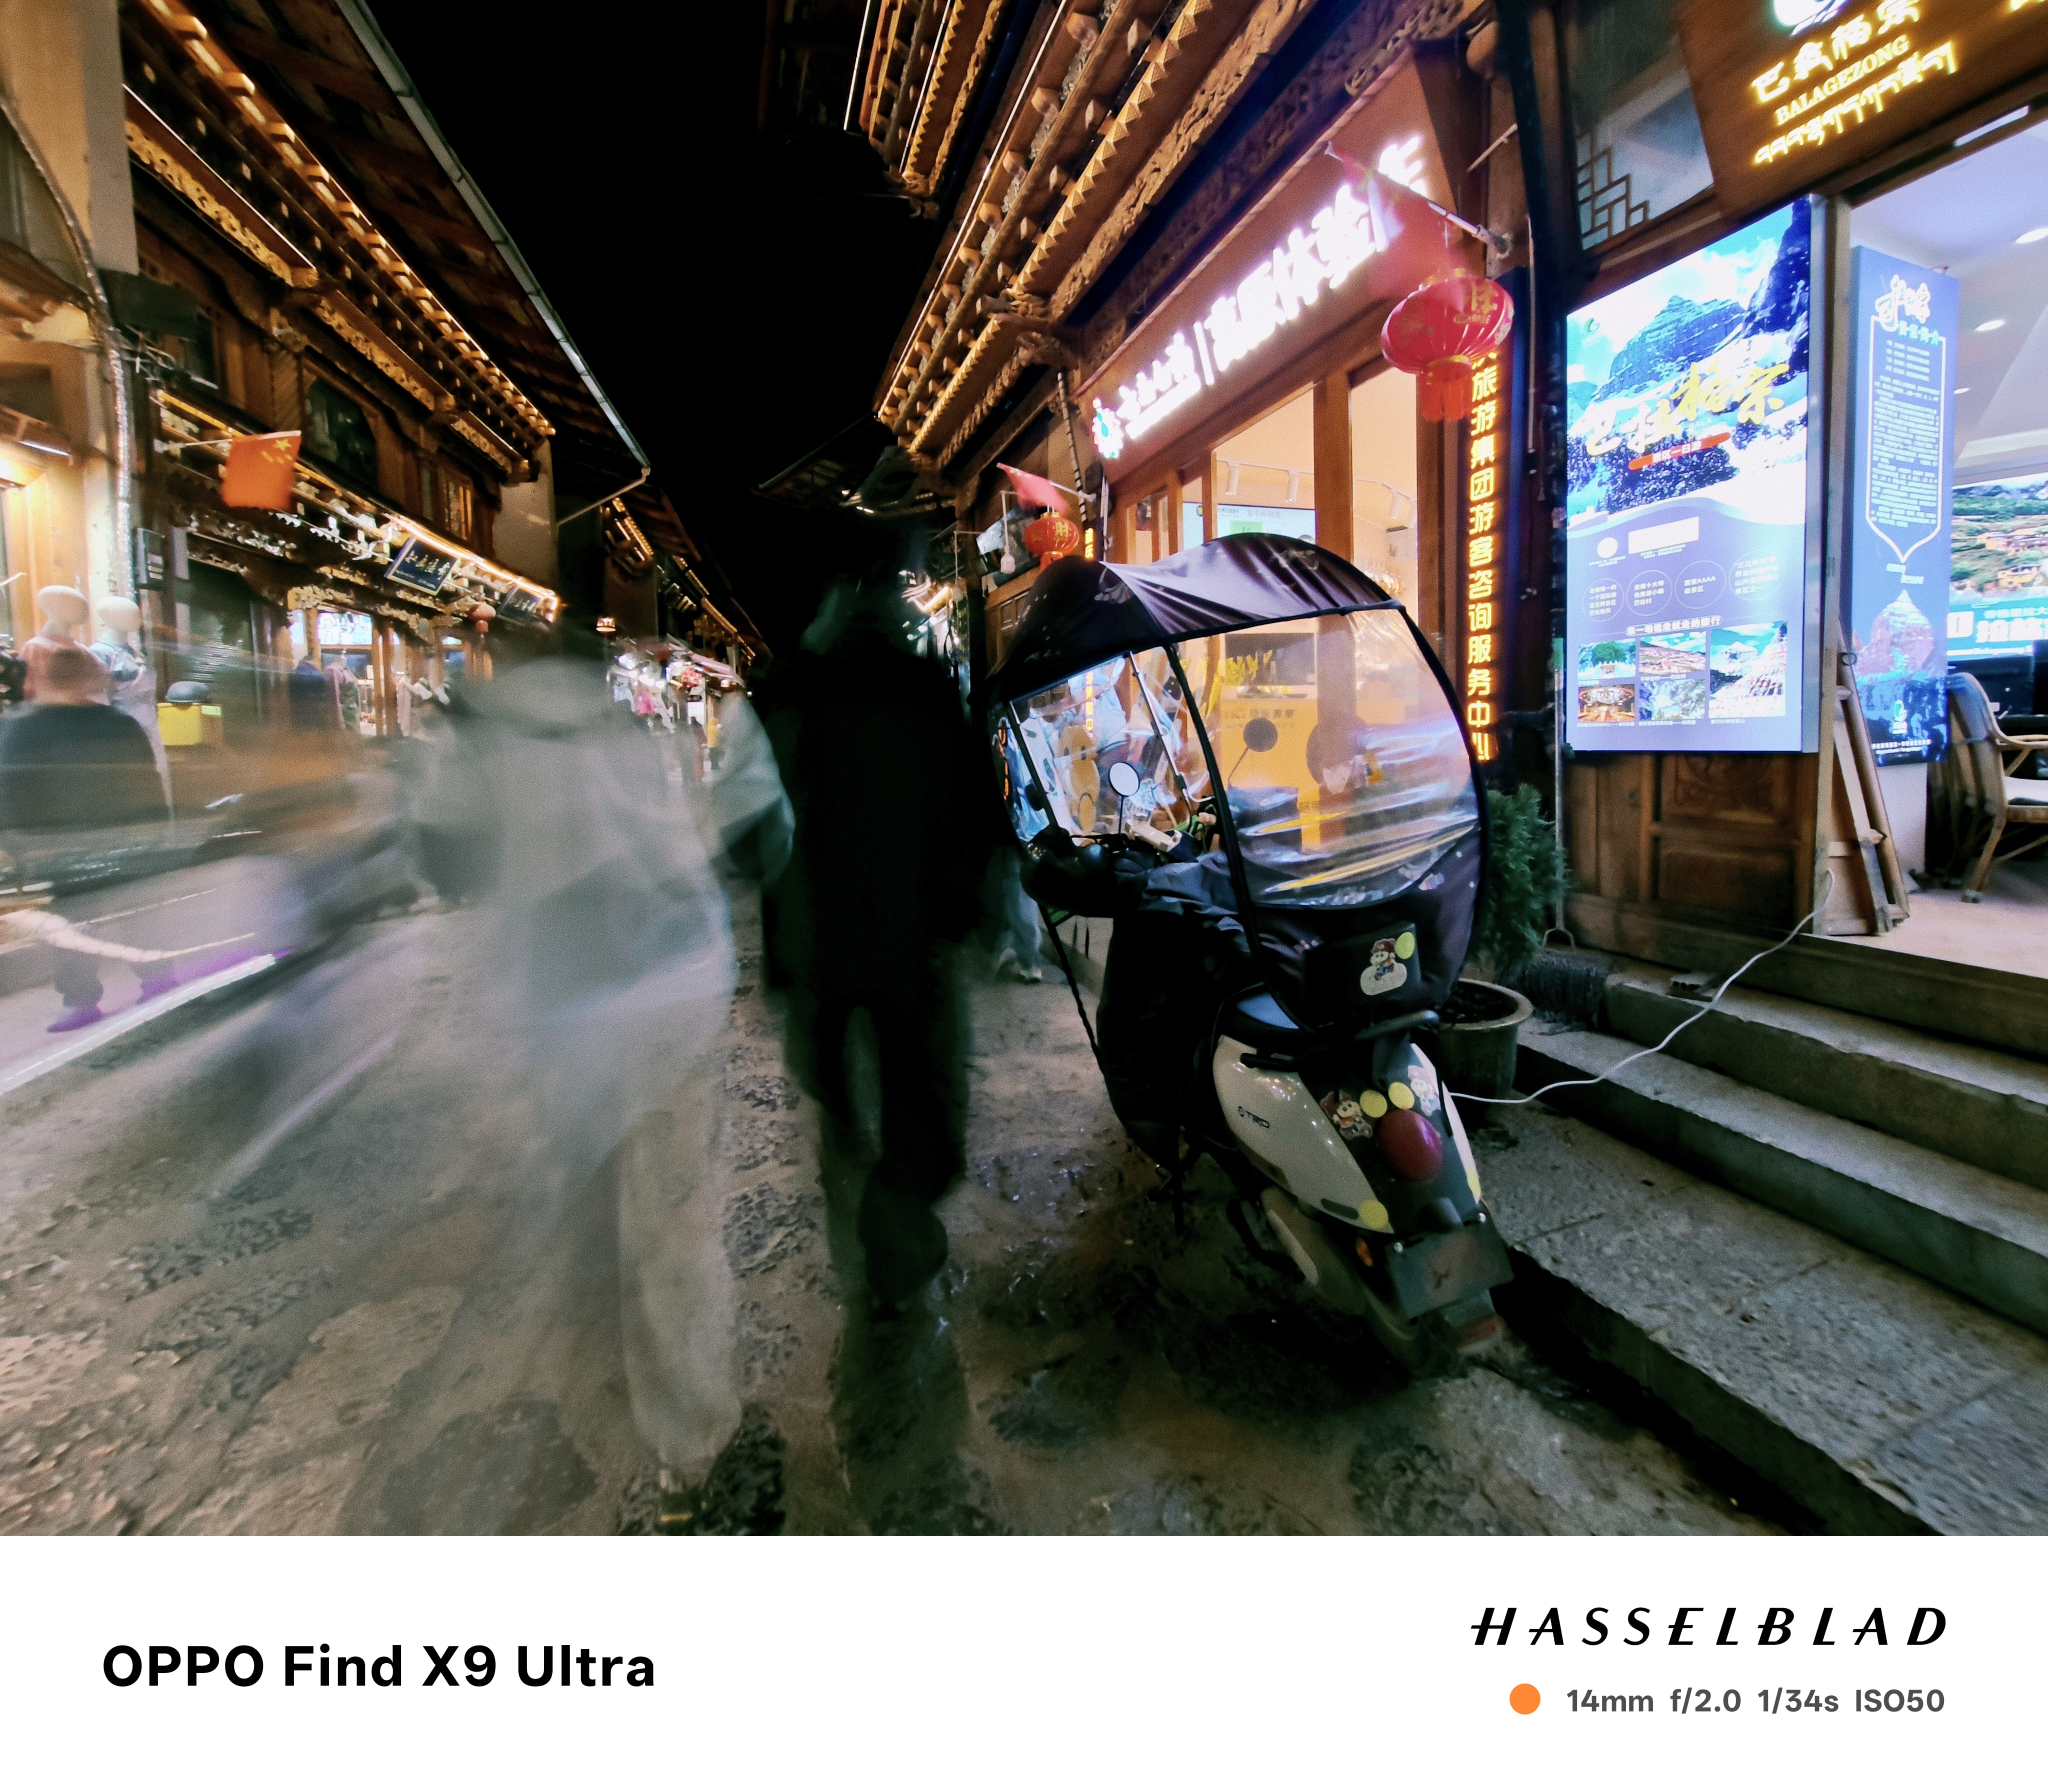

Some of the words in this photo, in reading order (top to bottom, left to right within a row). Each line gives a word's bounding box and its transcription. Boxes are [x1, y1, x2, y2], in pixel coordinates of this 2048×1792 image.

[1774, 34, 1910, 126] BALAGEZONG
[1466, 352, 1498, 761] 旅游集团游客咨询服务中心
